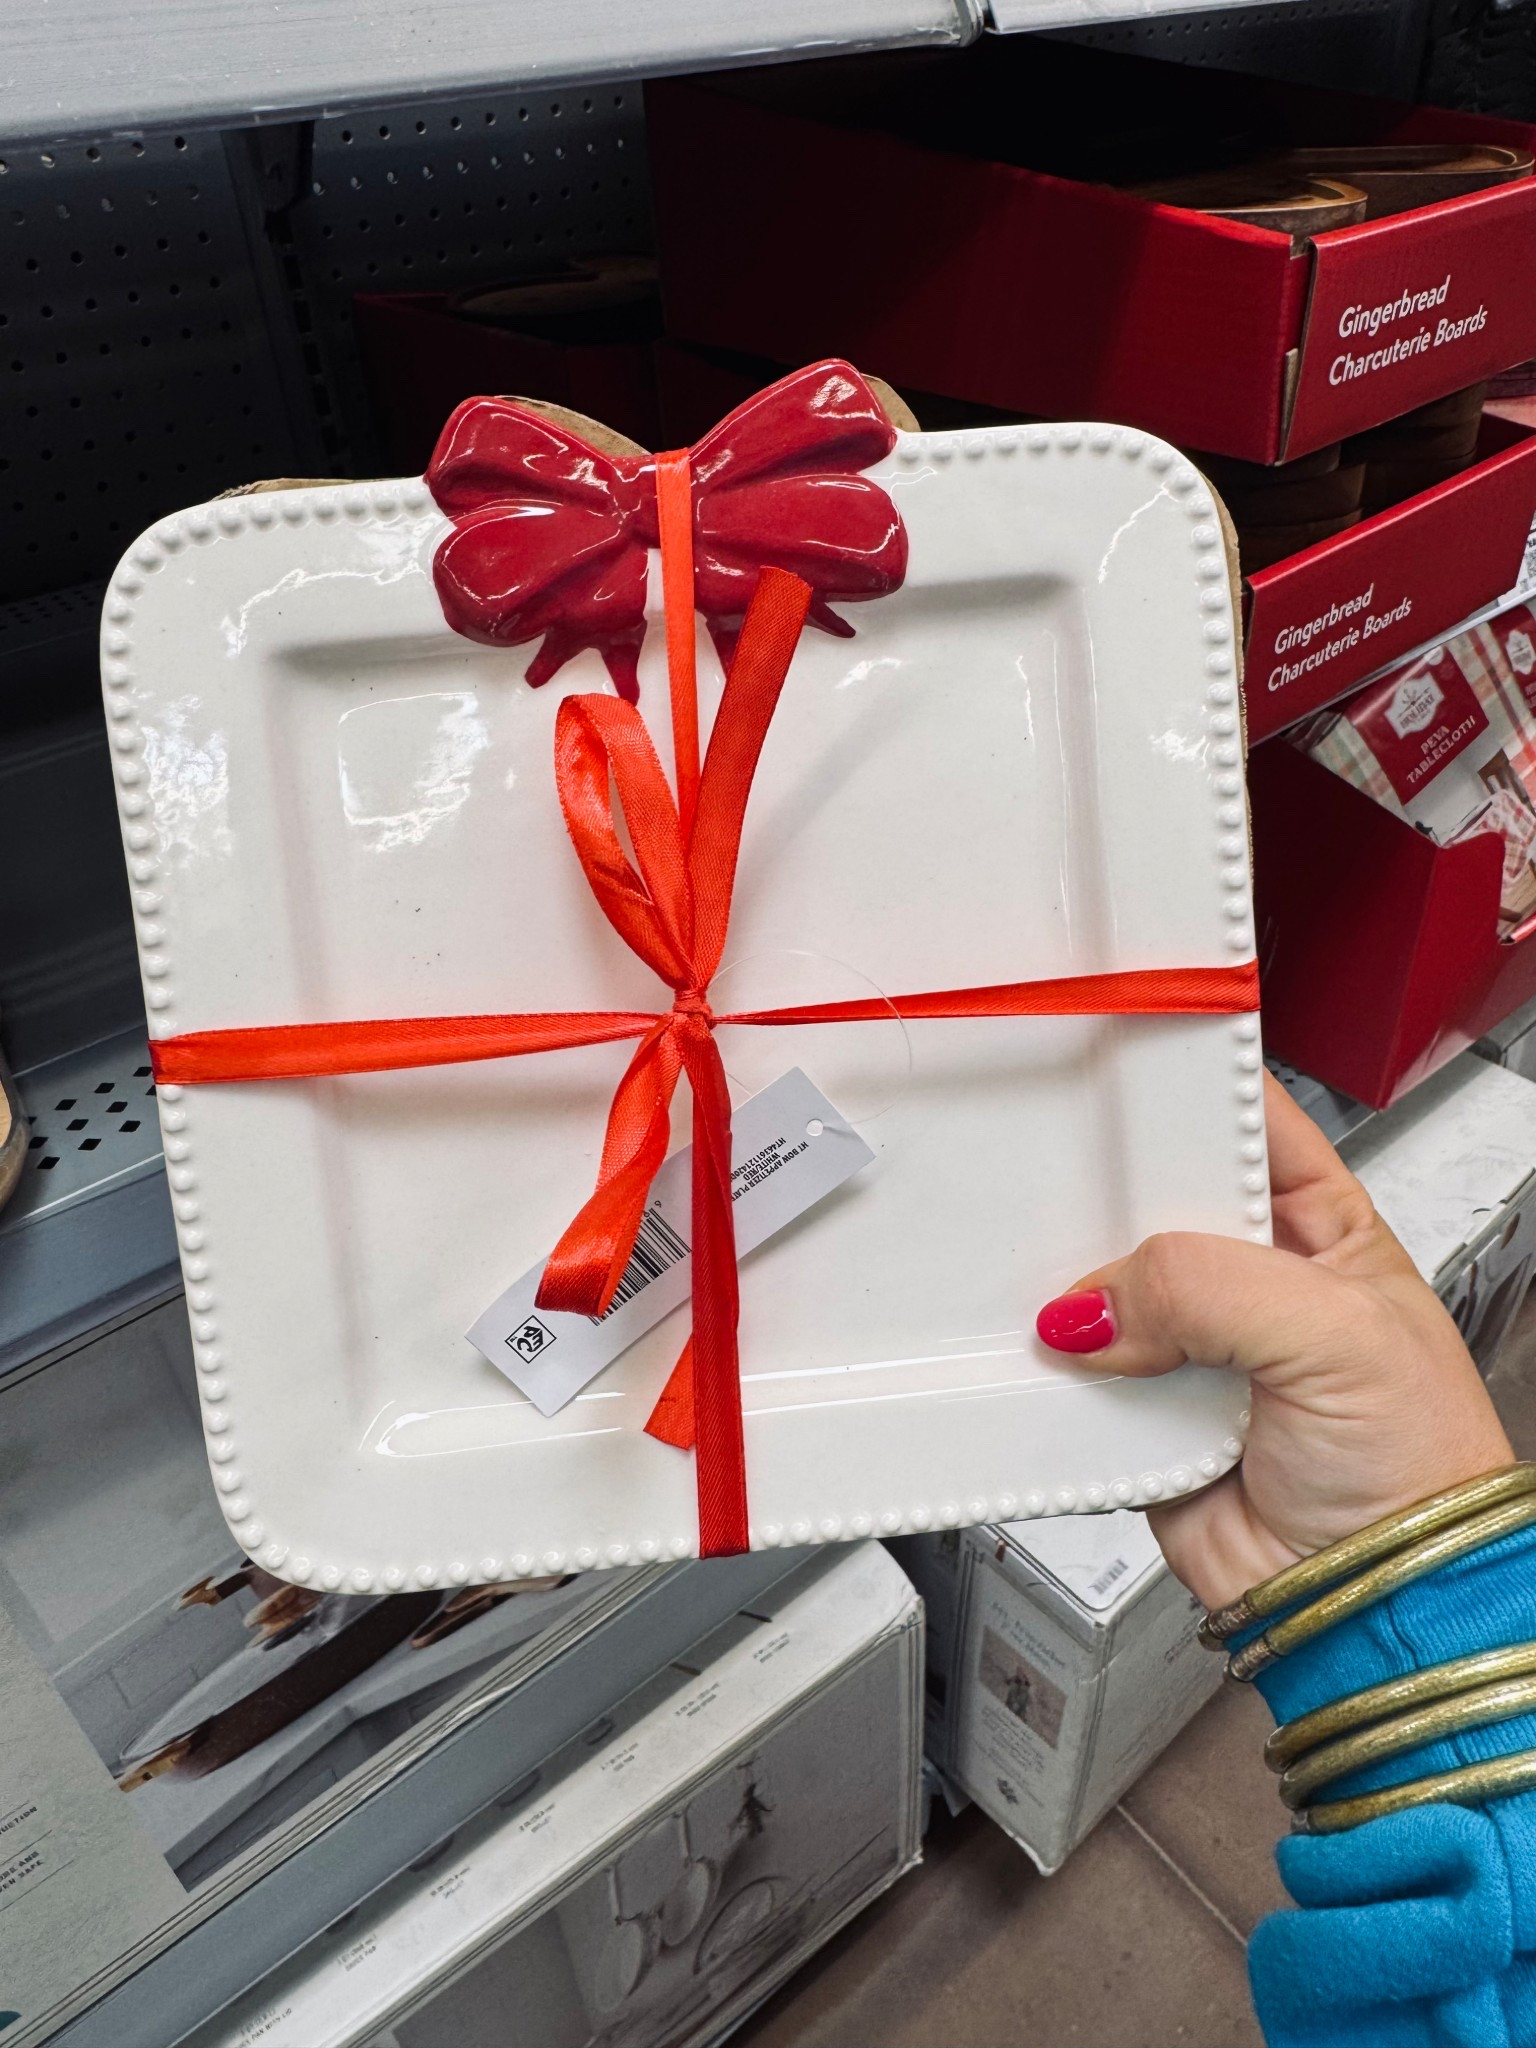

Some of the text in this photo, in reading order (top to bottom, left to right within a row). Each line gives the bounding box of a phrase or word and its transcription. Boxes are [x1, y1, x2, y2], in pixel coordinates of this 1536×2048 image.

[1338, 274, 1451, 338] Gingerbread
[1328, 304, 1489, 386] Charcuterie Boards
[1267, 596, 1412, 692] Charcuterie Boards
[1274, 582, 1374, 655] Gingerbread
[1406, 715, 1476, 783] TABLECLOTH
[1420, 725, 1450, 755] PEVA
[742, 1152, 781, 1181] WHITE/RED
[747, 1159, 783, 1188] APPETIZER
[781, 1148, 800, 1164] BOW
